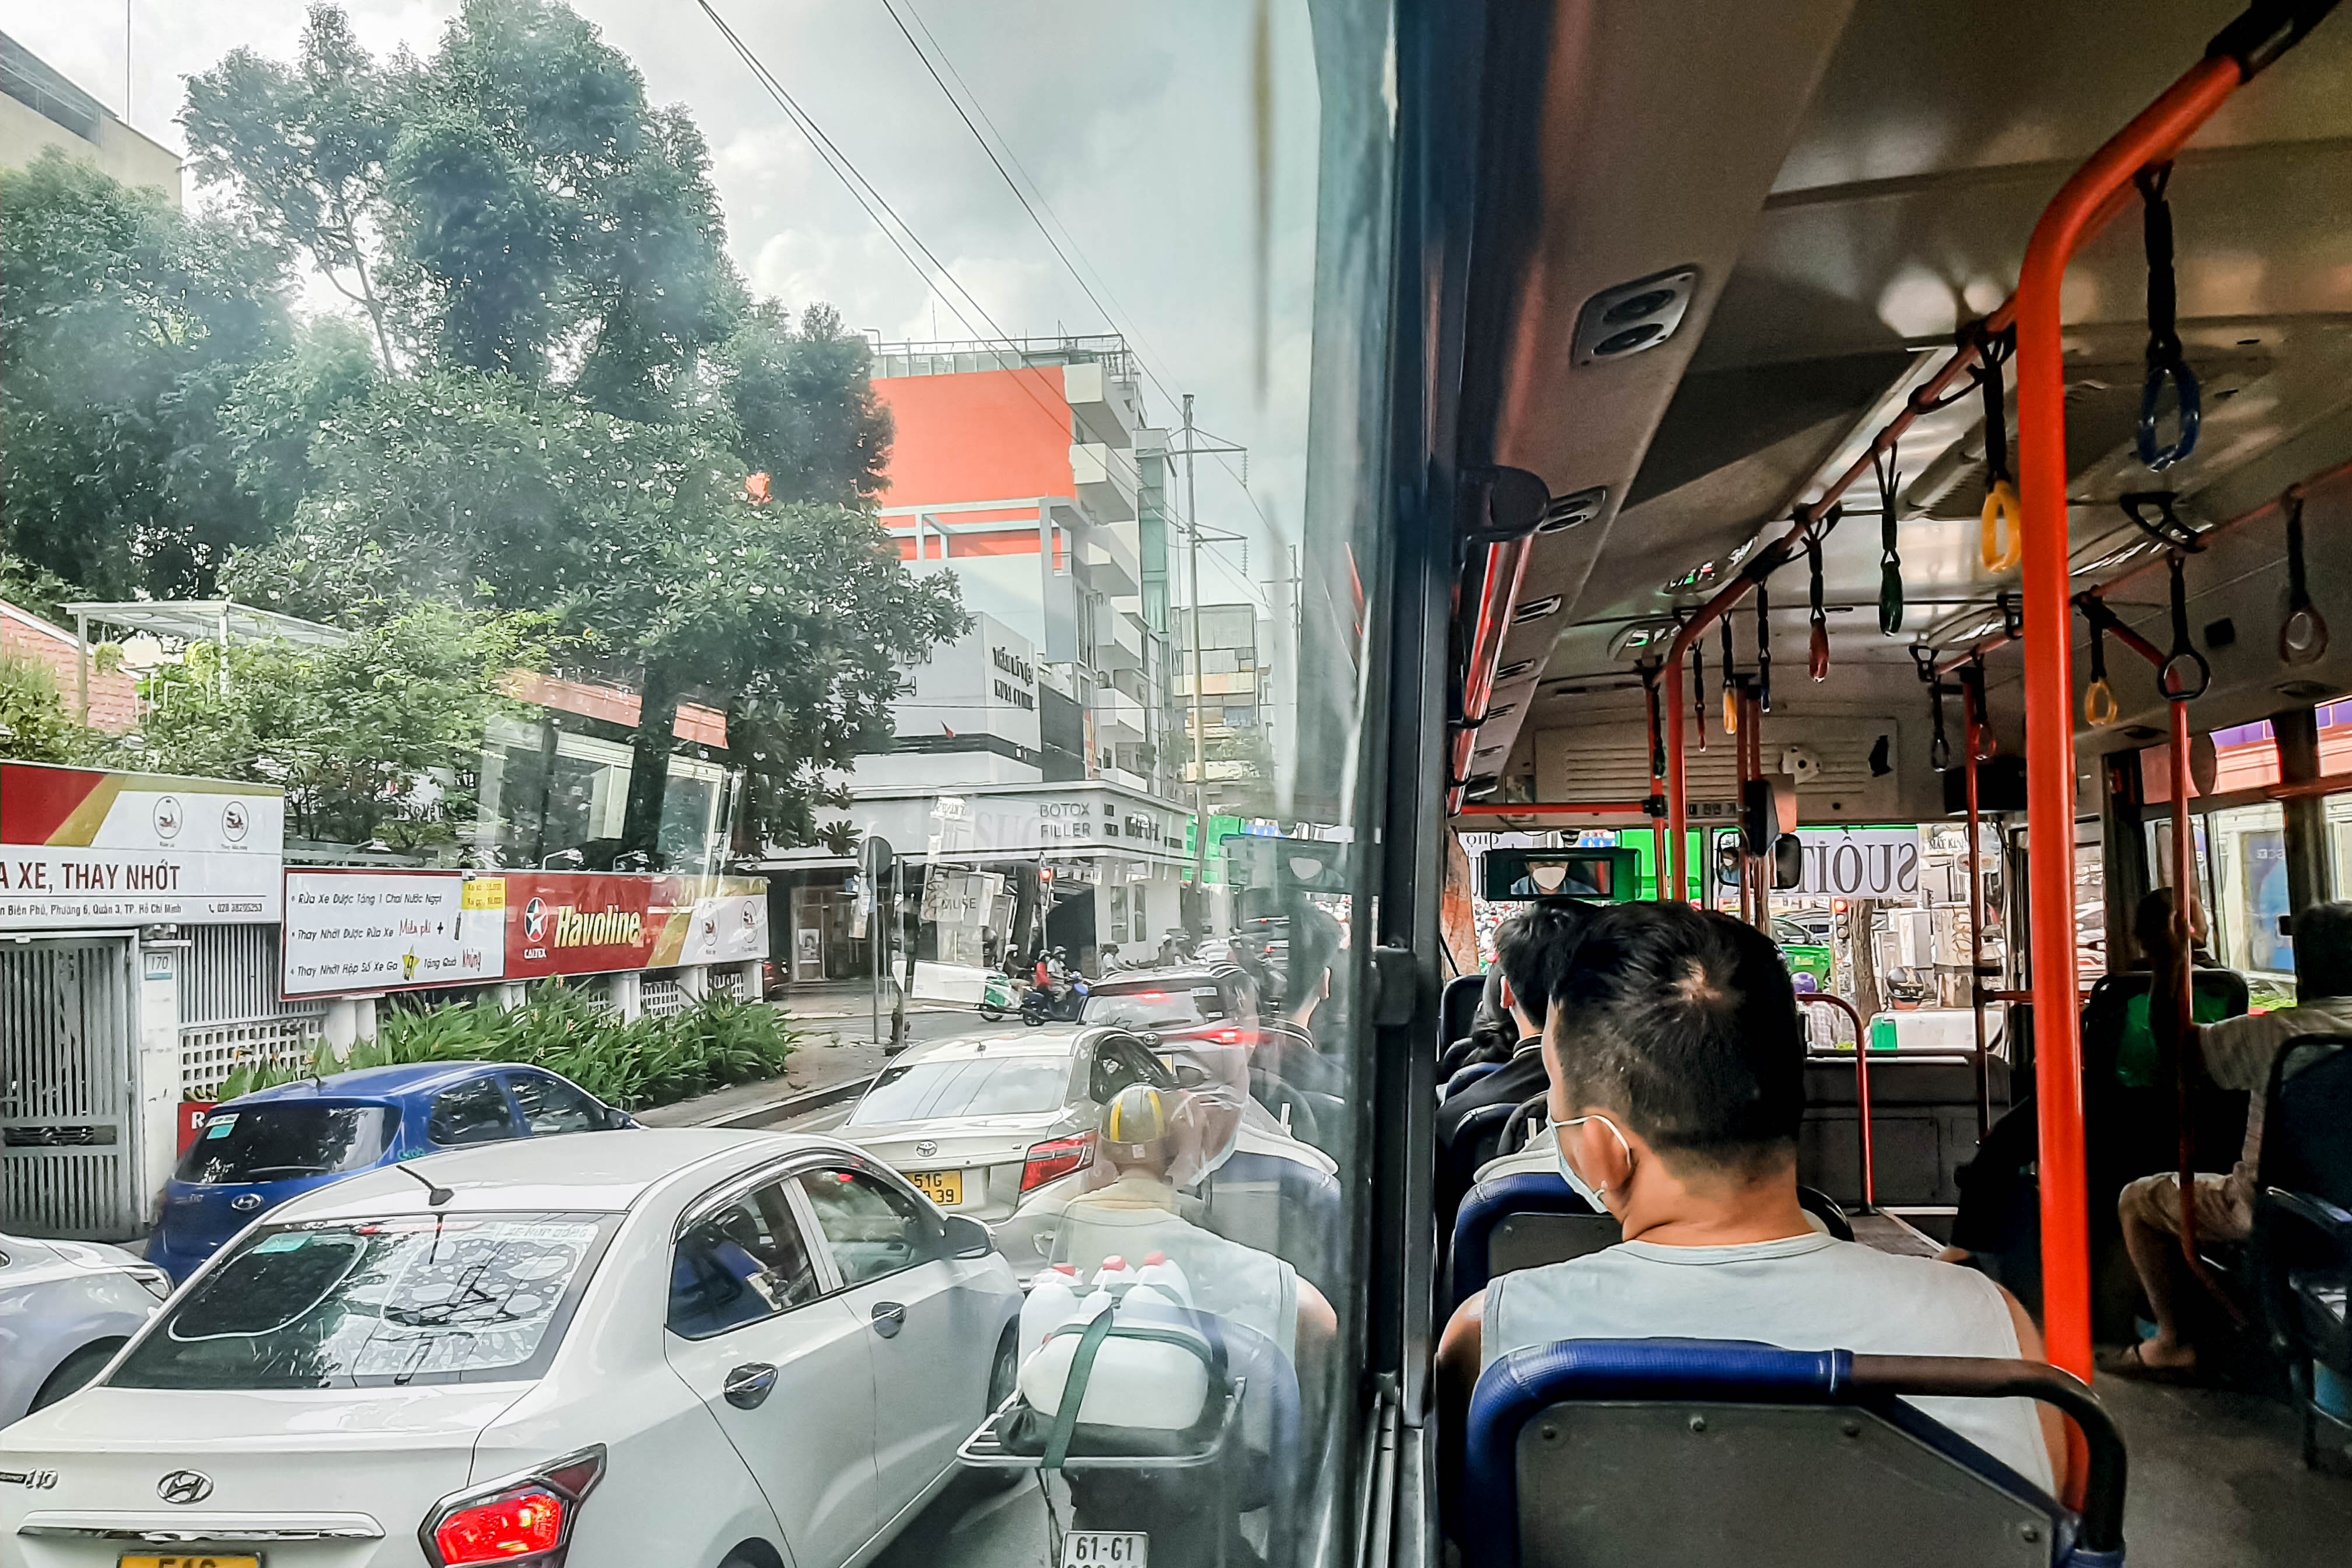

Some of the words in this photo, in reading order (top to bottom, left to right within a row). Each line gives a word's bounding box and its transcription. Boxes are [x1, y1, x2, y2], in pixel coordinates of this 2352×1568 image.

[1040, 803, 1090, 817] BOTOX
[1041, 822, 1091, 838] FILLER
[18, 862, 53, 894] XE,
[61, 863, 119, 890] THAY
[127, 859, 181, 890] NHỚT
[318, 894, 330, 903] Xe
[942, 898, 977, 911] MUSE
[554, 905, 641, 948] Havoline
[524, 948, 547, 959] CALTEX
[152, 956, 169, 971] 170
[914, 1172, 943, 1188] 51G
[1076, 1536, 1133, 1561] 61-G1
